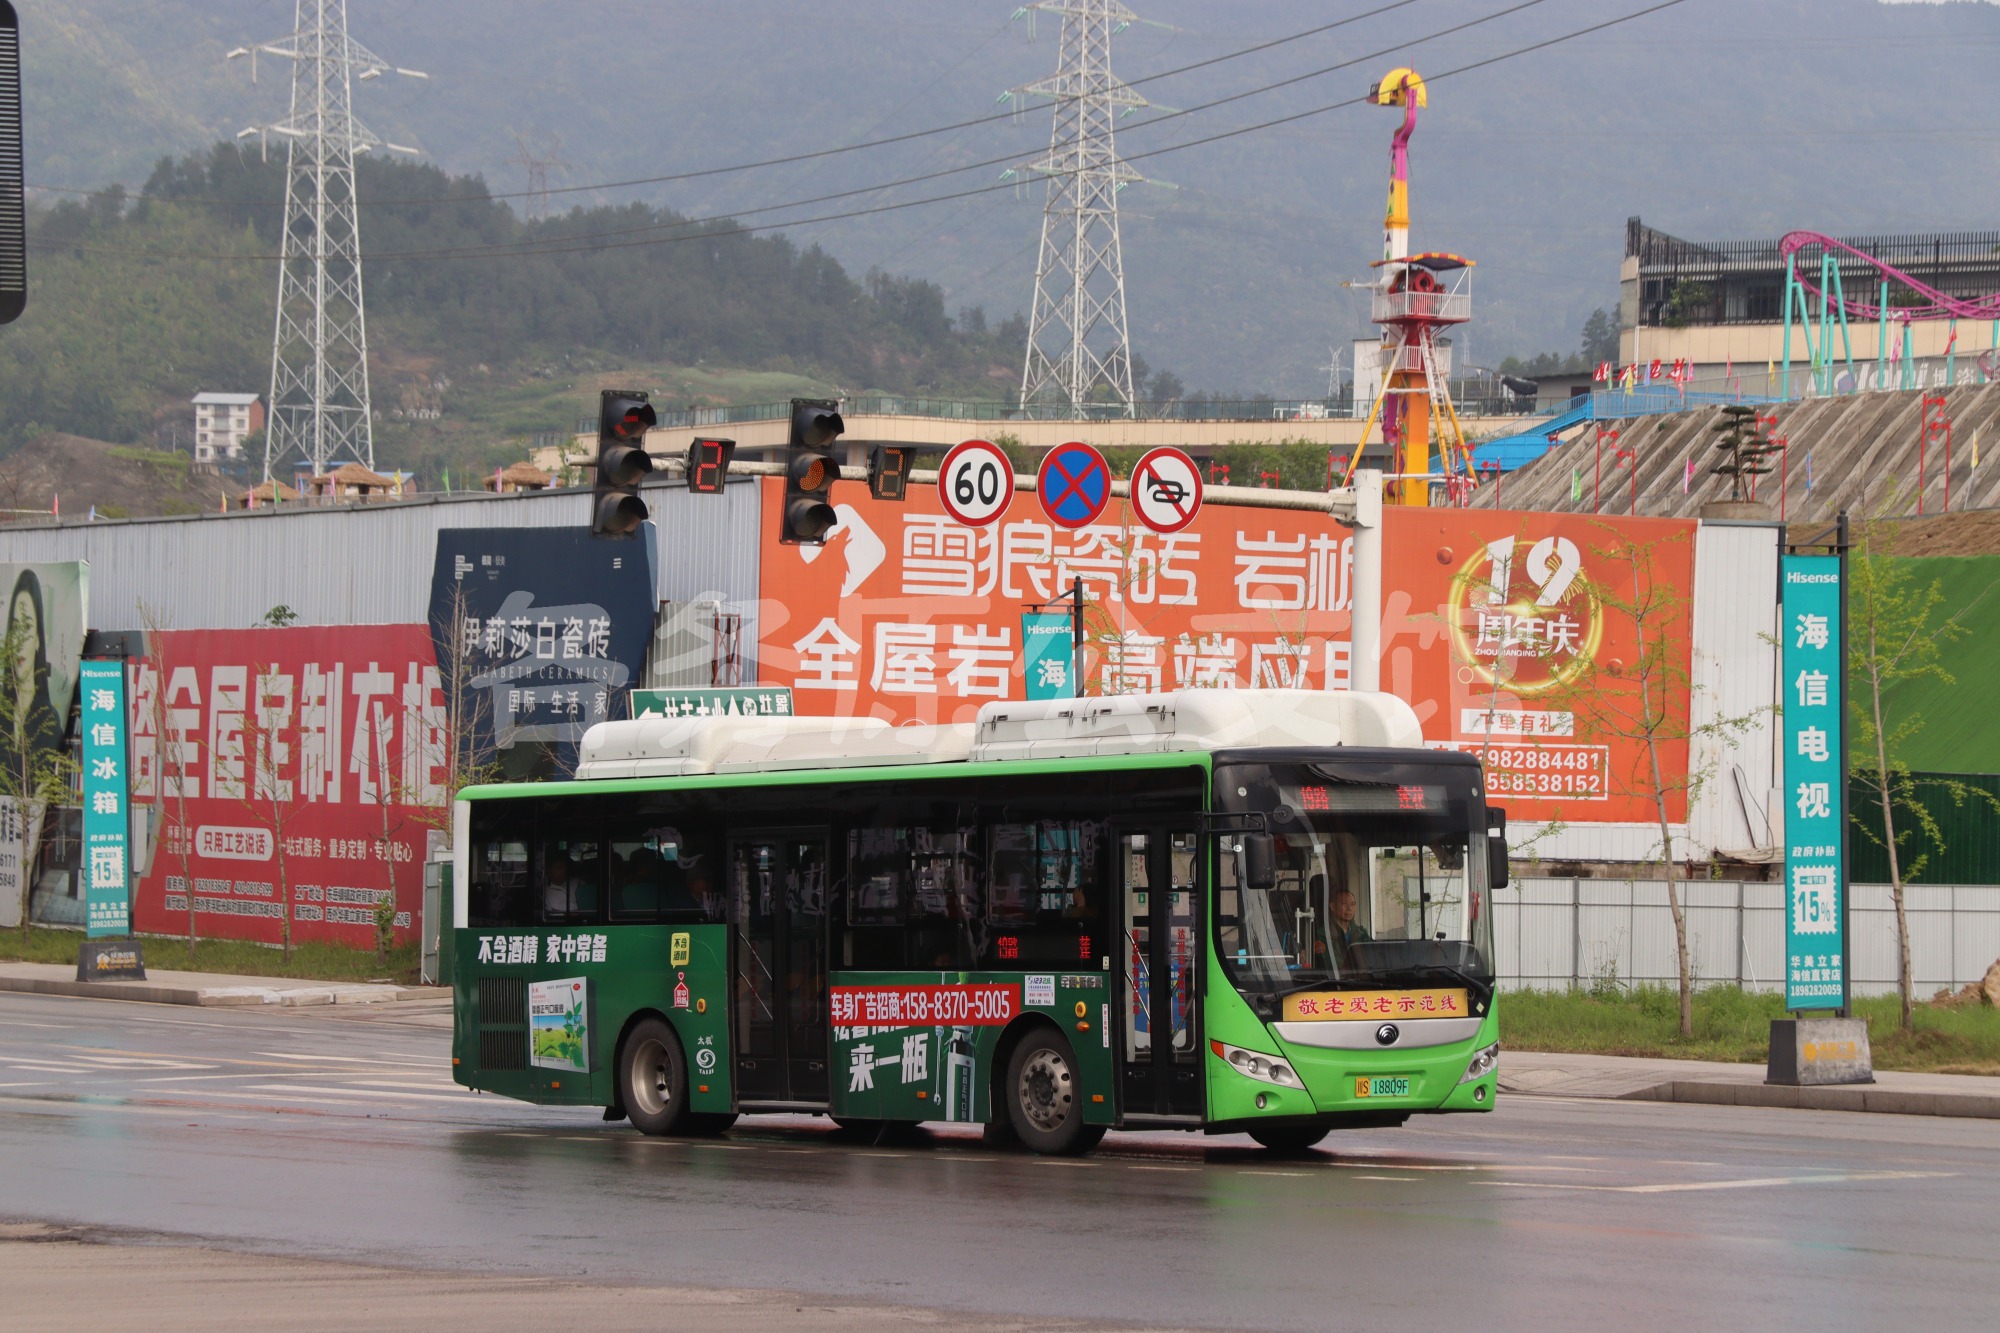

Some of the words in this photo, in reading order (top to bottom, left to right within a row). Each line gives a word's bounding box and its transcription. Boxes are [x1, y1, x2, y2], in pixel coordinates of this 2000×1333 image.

[954, 462, 998, 505] 60
[1485, 534, 1581, 606] 19
[1787, 572, 1838, 584] Hisense
[461, 615, 611, 660] 伊莉莎白瓷砖
[1027, 624, 1072, 636] Hisense
[1477, 612, 1580, 657] 周年庆
[1474, 648, 1537, 657] ZHOUIANQING
[82, 670, 121, 678] Hisense
[540, 665, 608, 679] CERAMICS
[1037, 658, 1067, 688] 海
[1479, 714, 1556, 733] 下单有礼
[1795, 613, 1831, 818] 海信电视
[90, 688, 119, 814] 海信冰箱
[204, 832, 265, 855] 只用工艺说话
[1792, 846, 1836, 857] 政府补贴
[1798, 891, 1831, 922] 15%
[478, 935, 538, 964] 不含酒精
[546, 934, 607, 963] 家中常备
[673, 938, 687, 948] 不含
[1791, 954, 1841, 967] 华美立家
[1791, 968, 1841, 982] 海信直营店
[1791, 984, 1841, 997] 18982820059
[1298, 994, 1457, 1015] 敬老爱老示范线
[849, 1033, 928, 1092] 来一瓶
[1373, 1079, 1408, 1095] 18809F
